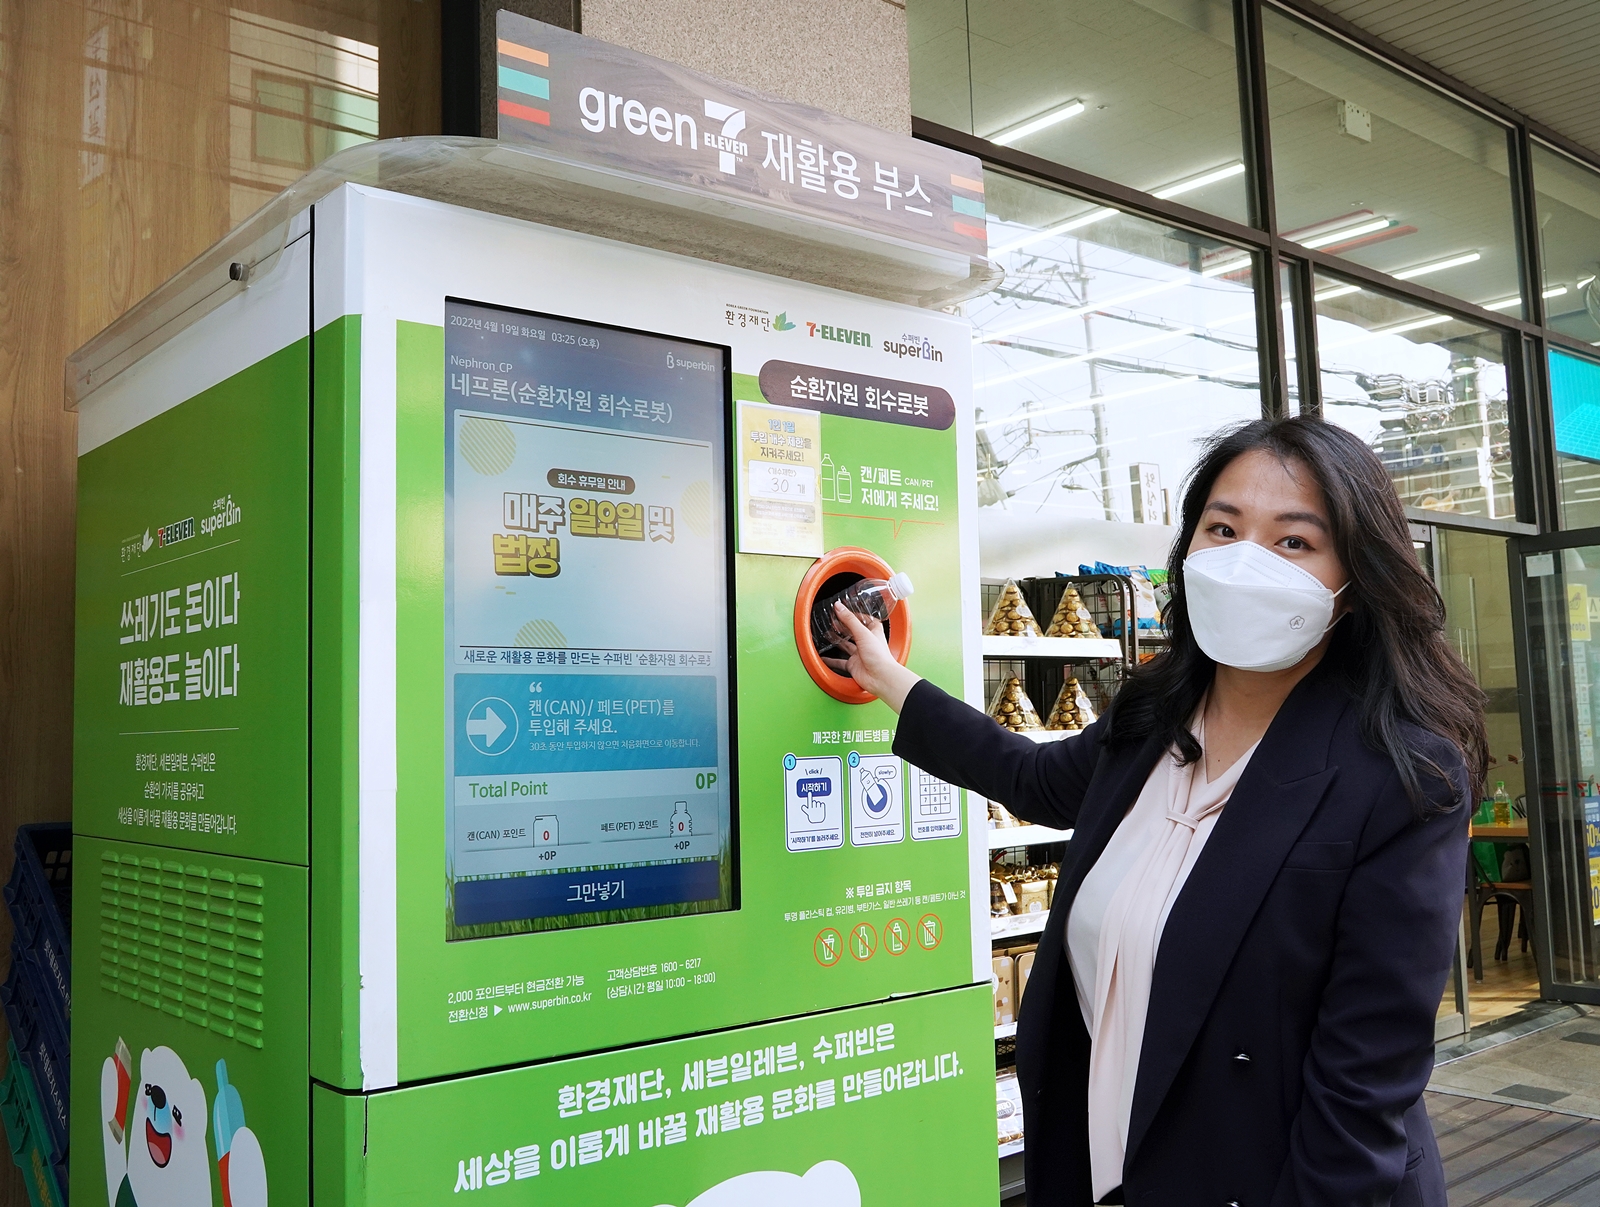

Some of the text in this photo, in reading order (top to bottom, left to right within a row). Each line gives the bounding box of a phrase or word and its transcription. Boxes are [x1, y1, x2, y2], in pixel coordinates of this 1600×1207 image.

[579, 85, 698, 150] green
[704, 132, 748, 157] ELEVEN
[760, 129, 933, 217] 재활용 부스
[450, 315, 600, 349] 2022년 4월 19일 화요일 03:25 (오후)
[806, 321, 872, 348] 7-ELEVEN
[901, 333, 920, 345] 수퍼빈
[451, 355, 513, 374] Nephron_CP
[676, 357, 715, 372] superbin
[451, 373, 673, 424] 네프론(순환자원 회수로봇)
[790, 375, 929, 417] 순환자원 회수로봇
[768, 419, 795, 433] 1인 1일
[750, 431, 812, 449] 투입 개수 제한을
[760, 447, 804, 462] 지켜주세요!
[557, 473, 626, 490] 회수 휴무일 안내
[860, 465, 902, 486] 캔/페트
[771, 477, 805, 494] 30 개
[213, 497, 225, 512] 수퍼빈
[861, 487, 939, 511] 저에게 주세요!
[503, 492, 675, 544] 매주 일요일 및
[158, 516, 195, 548] 7-ELEVEN
[492, 534, 561, 578] 법정
[120, 571, 240, 645] 쓰레기도 돈이다
[463, 650, 497, 664] 새로운
[500, 650, 533, 664] 재활용
[535, 651, 568, 665] 문화를
[570, 652, 601, 665] 만드는
[603, 652, 632, 665] 수퍼빈
[635, 653, 676, 666] '순환자원
[119, 643, 240, 706] 재활용도 놀이다
[528, 699, 675, 717] 캔(CAN)/ 페트(PET)를
[528, 718, 618, 736] 투입해 주세요.
[812, 731, 840, 744] 깨끗한
[842, 729, 890, 743] 캔/페트병을
[529, 738, 701, 751] 30초 동안 투입하지 않으면 처음화면으로 이동합니다.
[135, 752, 216, 772] 환경재단, 세븐일레븐, 수퍼빈은
[469, 781, 548, 798] Total Point
[695, 772, 717, 789] 0P
[801, 782, 827, 793] 시작하기
[144, 781, 204, 801] 순환의 가치를 공유하고
[118, 806, 238, 835] 세상을 이롭게 바꿀 재활용 문화를 만들어갑니다.
[600, 819, 659, 833] 페트(PET) 포인트
[678, 822, 684, 832] 0
[467, 828, 526, 841] 캔(CAN) 포인트
[543, 830, 550, 841] 0
[674, 840, 690, 851] +0P
[538, 851, 557, 861] +0P
[566, 880, 625, 903] 그만넣기
[856, 880, 912, 898] 투입 금지 항목
[784, 912, 797, 922] 투명
[799, 909, 824, 920] 플라스틱
[883, 899, 896, 909] 일반
[896, 897, 914, 907] 쓰레기
[915, 896, 921, 905] 등
[922, 893, 947, 904] 캔/페트가
[948, 891, 959, 900] 아닌
[960, 890, 966, 899] 것
[607, 958, 702, 982] 고객상담번호 1600 6217
[448, 975, 585, 1005] 2,000 포인트부터 현금전환 가능
[607, 971, 716, 1000] (상담시간 평일 10:00 18:00)
[508, 991, 592, 1013] www.superbin.co.kr
[448, 1005, 488, 1023] 전환신청
[558, 1022, 896, 1120] 환경재단, 세븐일레븐, 수퍼빈은
[453, 1051, 965, 1194] 세상을 이롭게 바꿀 재활용 문화를 만들어갑니다.
